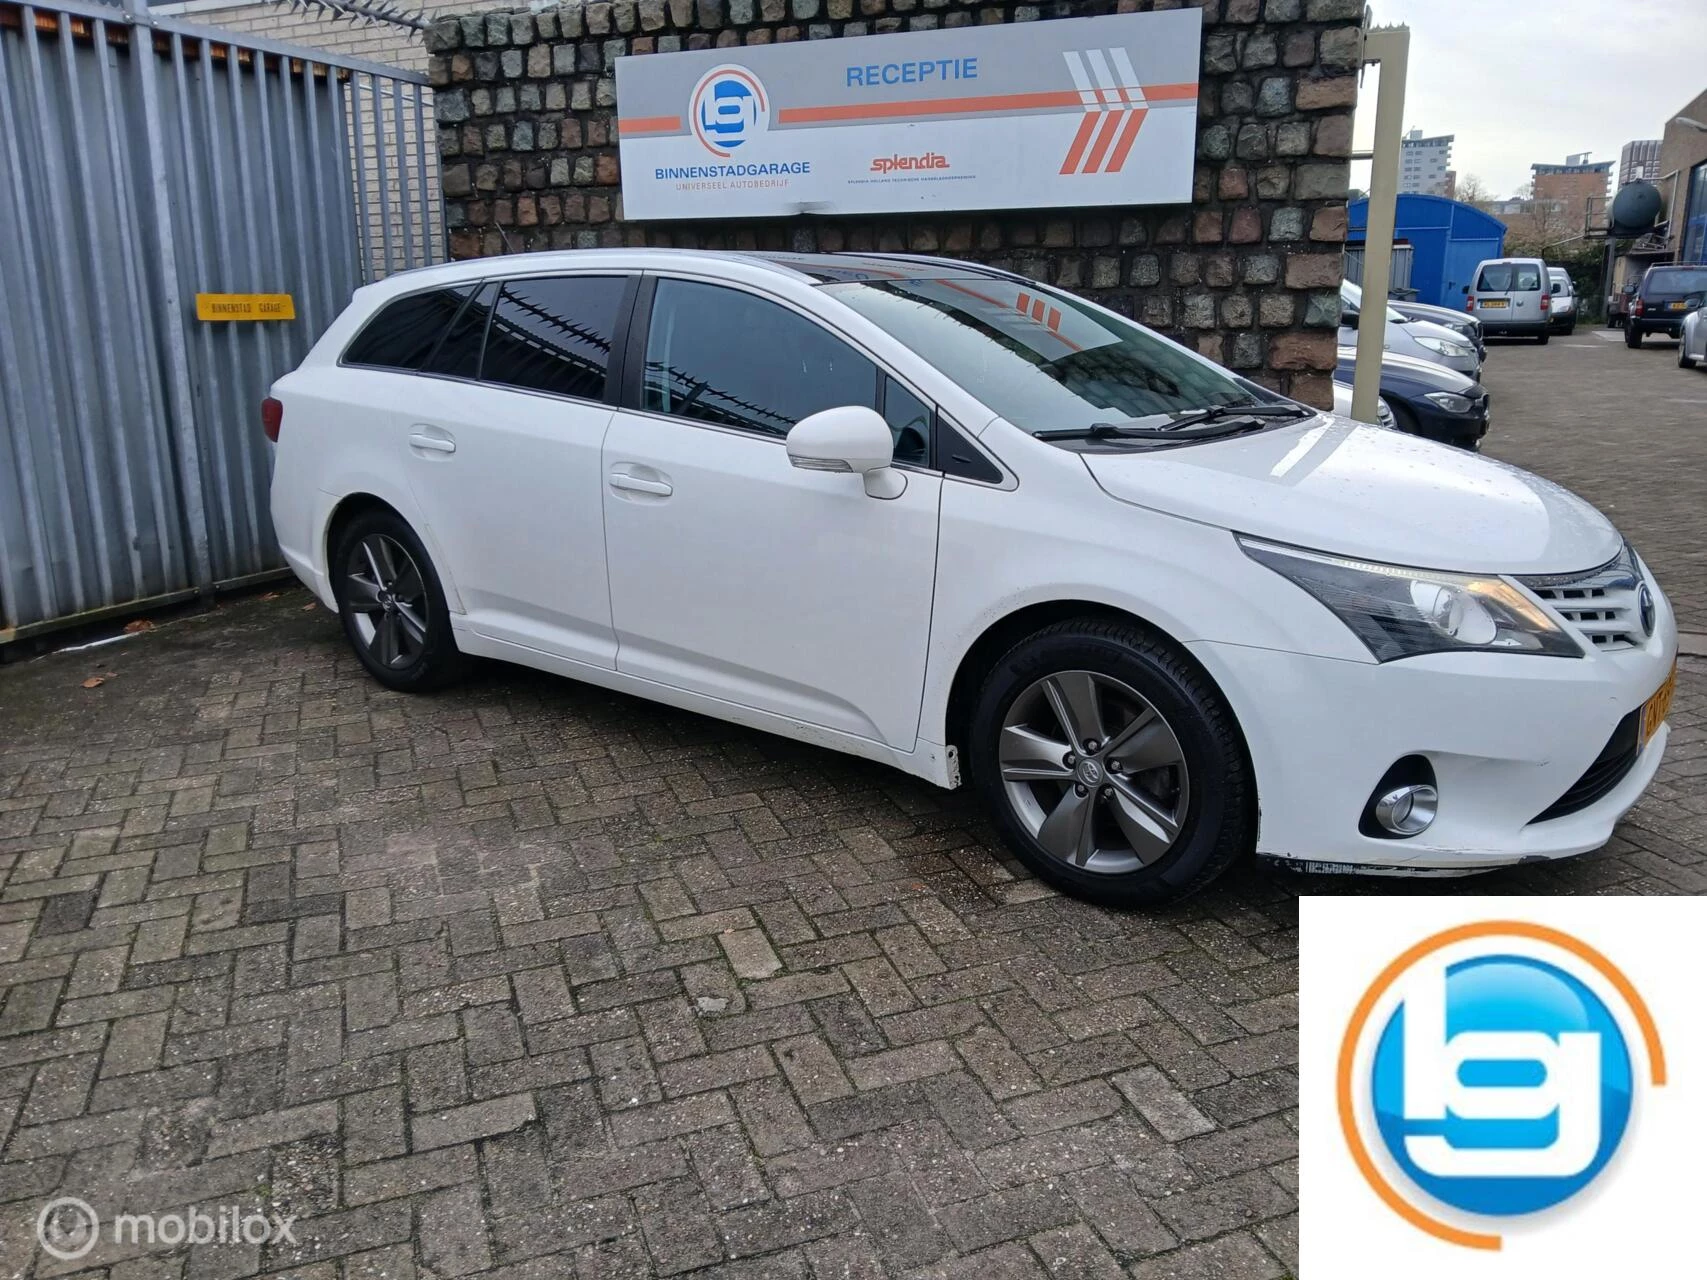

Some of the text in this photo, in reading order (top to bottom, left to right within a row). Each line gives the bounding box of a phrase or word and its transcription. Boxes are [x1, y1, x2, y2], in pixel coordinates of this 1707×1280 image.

[846, 57, 978, 87] RECEPTIE
[655, 161, 811, 180] BINNENSTADGARAGE
[870, 152, 950, 174] splendia
[676, 179, 790, 191] UNIVERSEEL AUTOBEDRIJF
[211, 302, 281, 313] BINNENSTAD GARAGE
